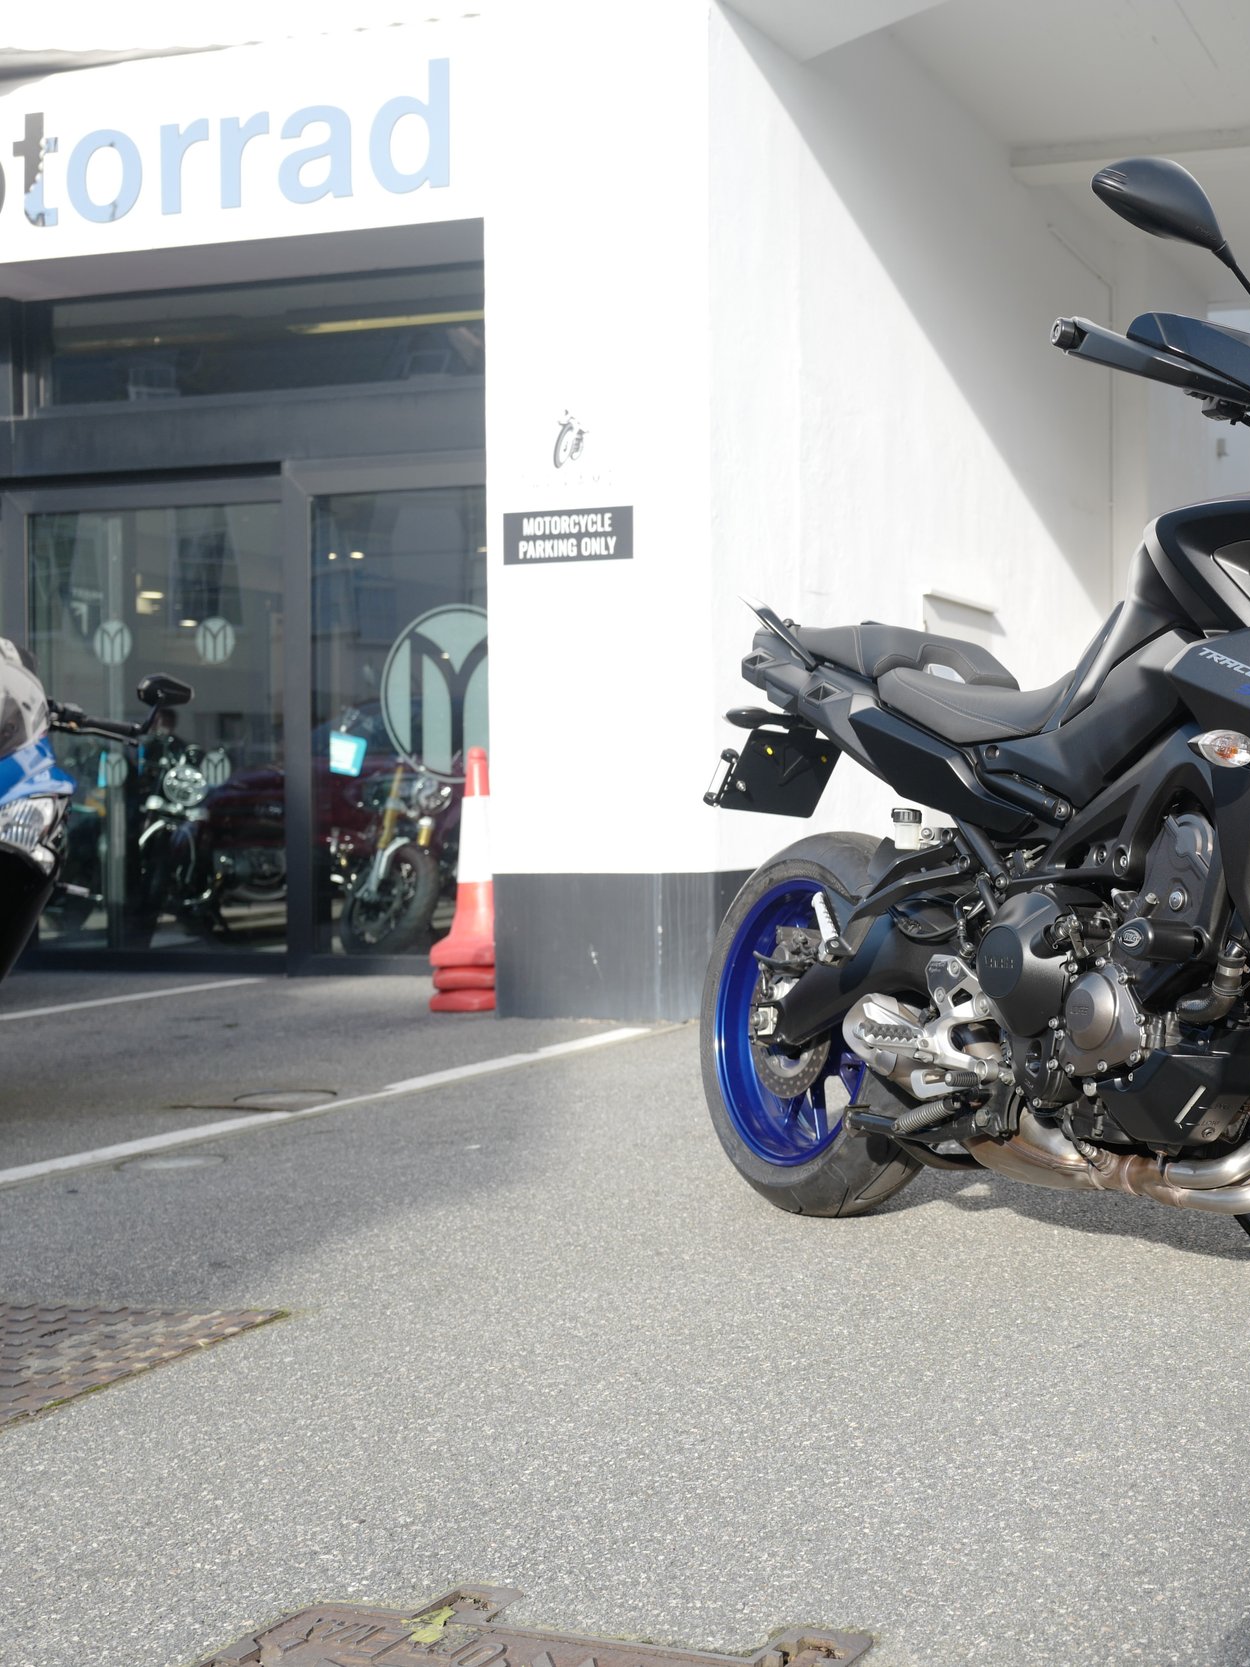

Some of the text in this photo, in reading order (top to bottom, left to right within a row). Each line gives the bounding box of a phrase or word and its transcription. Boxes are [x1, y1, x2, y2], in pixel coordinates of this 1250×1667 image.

[0, 57, 450, 228] torrad
[522, 513, 613, 537] MOTORCYCLE
[518, 536, 617, 560] PARKING ONLY
